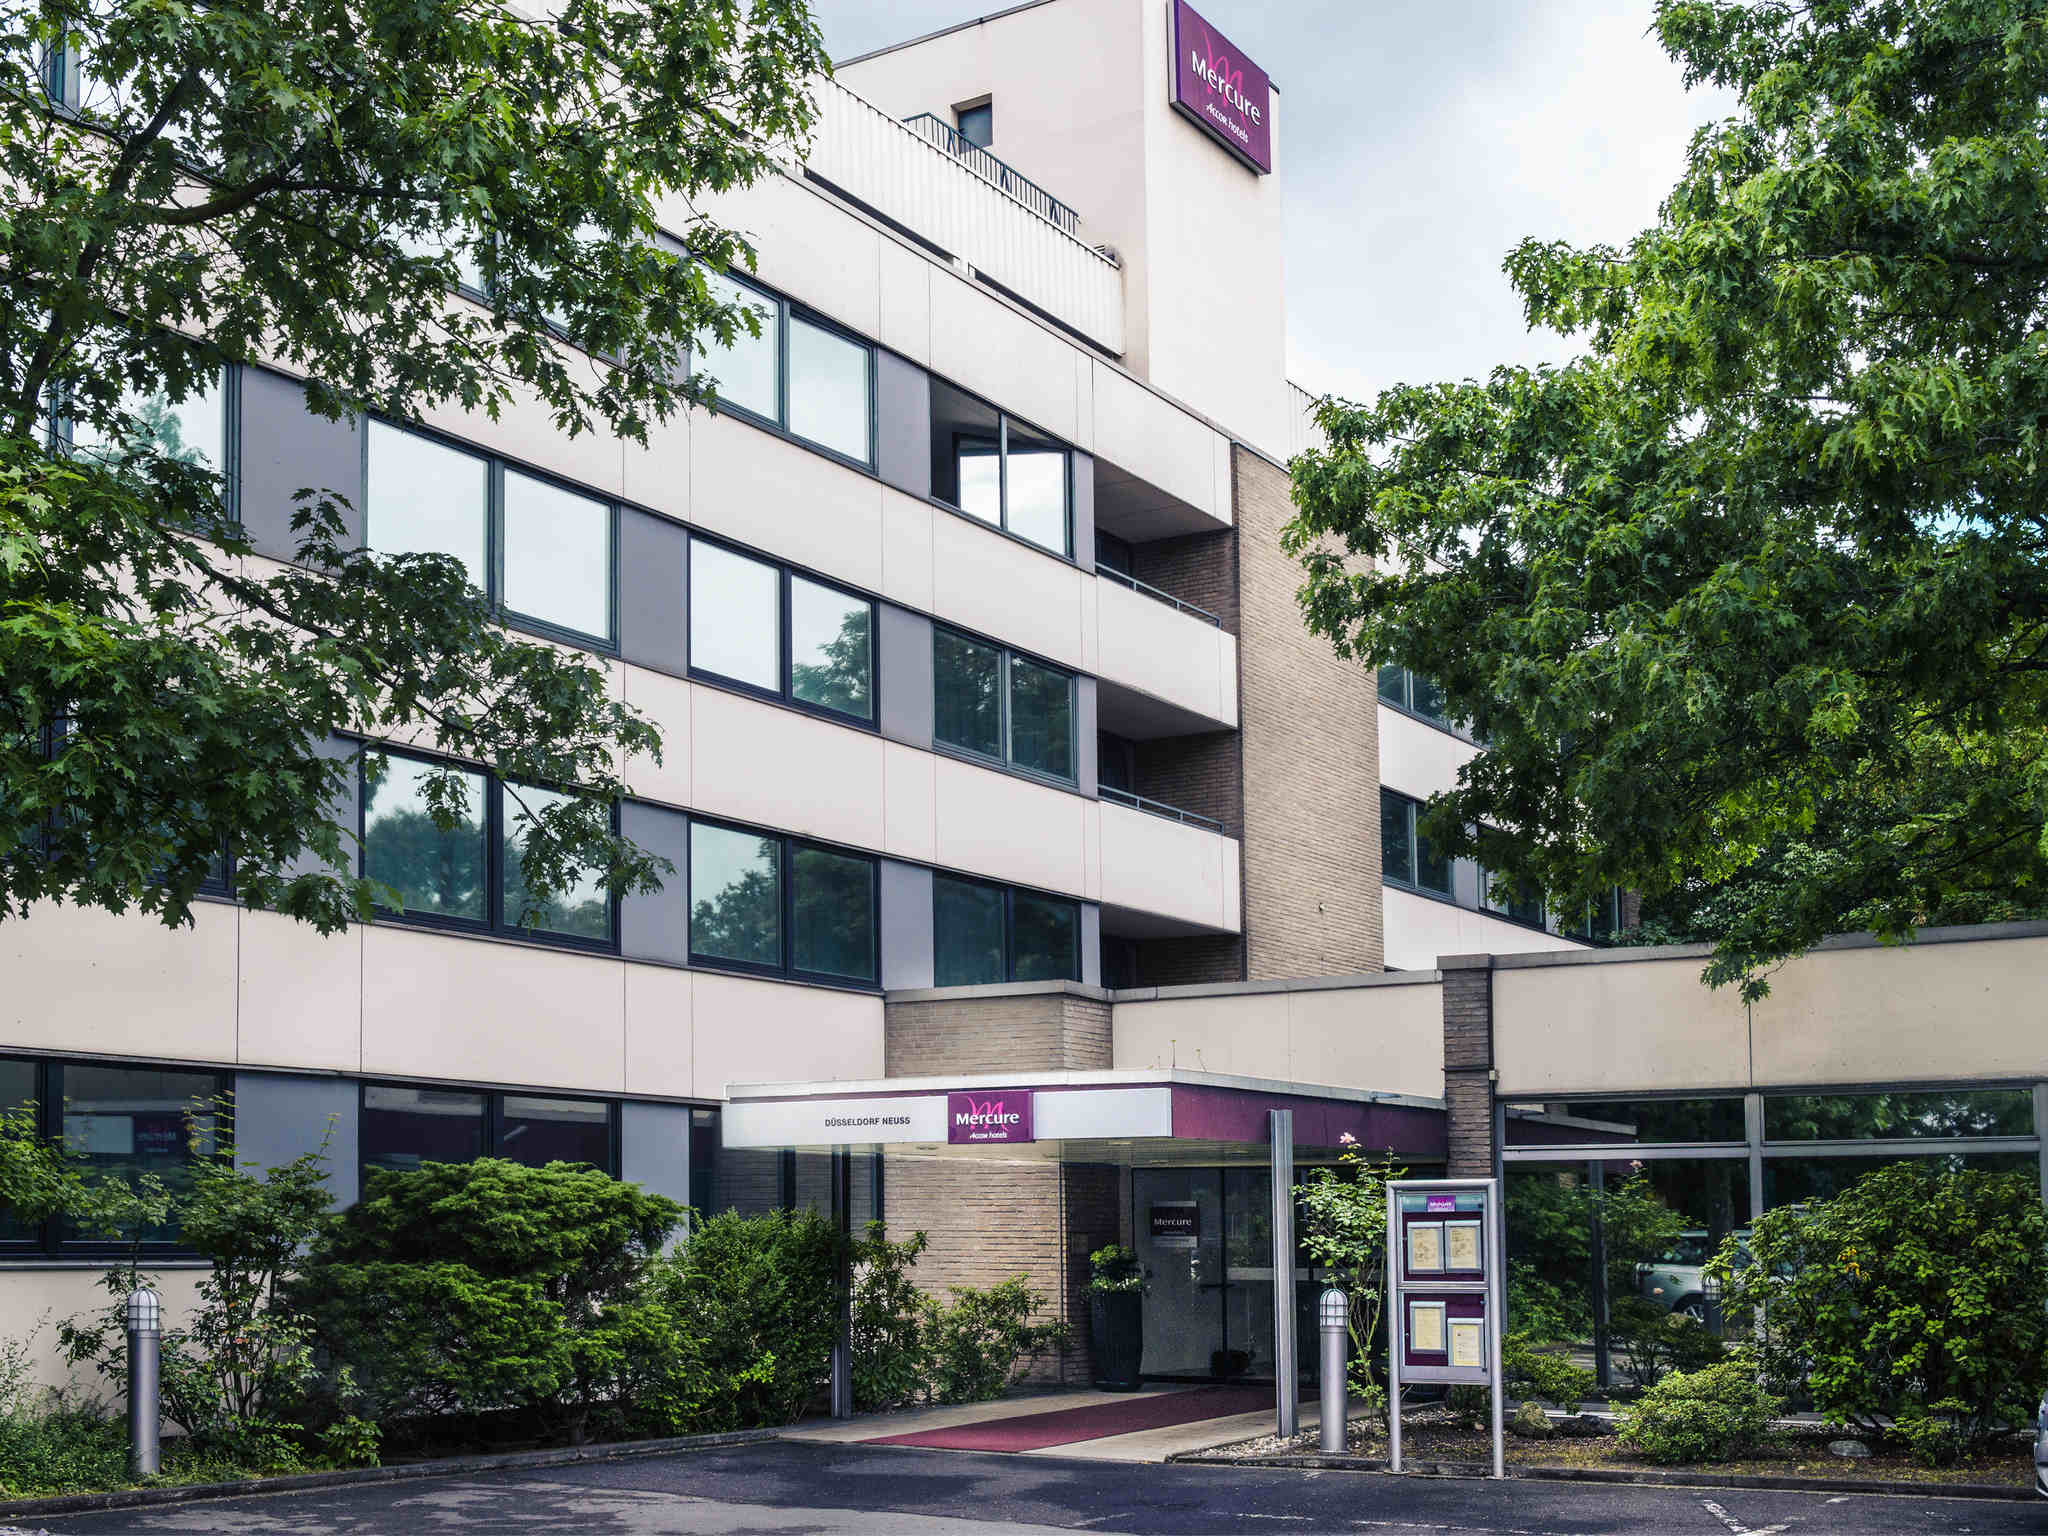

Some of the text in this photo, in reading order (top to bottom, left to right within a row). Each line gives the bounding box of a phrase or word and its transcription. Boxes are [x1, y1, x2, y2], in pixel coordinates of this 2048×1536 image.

[1191, 50, 1261, 126] Mercure
[1228, 116, 1249, 144] hotels
[824, 1116, 911, 1127] DÜSSELDORF NEUSS
[956, 1112, 1020, 1125] Mercure
[1154, 1217, 1192, 1226] Mercure
